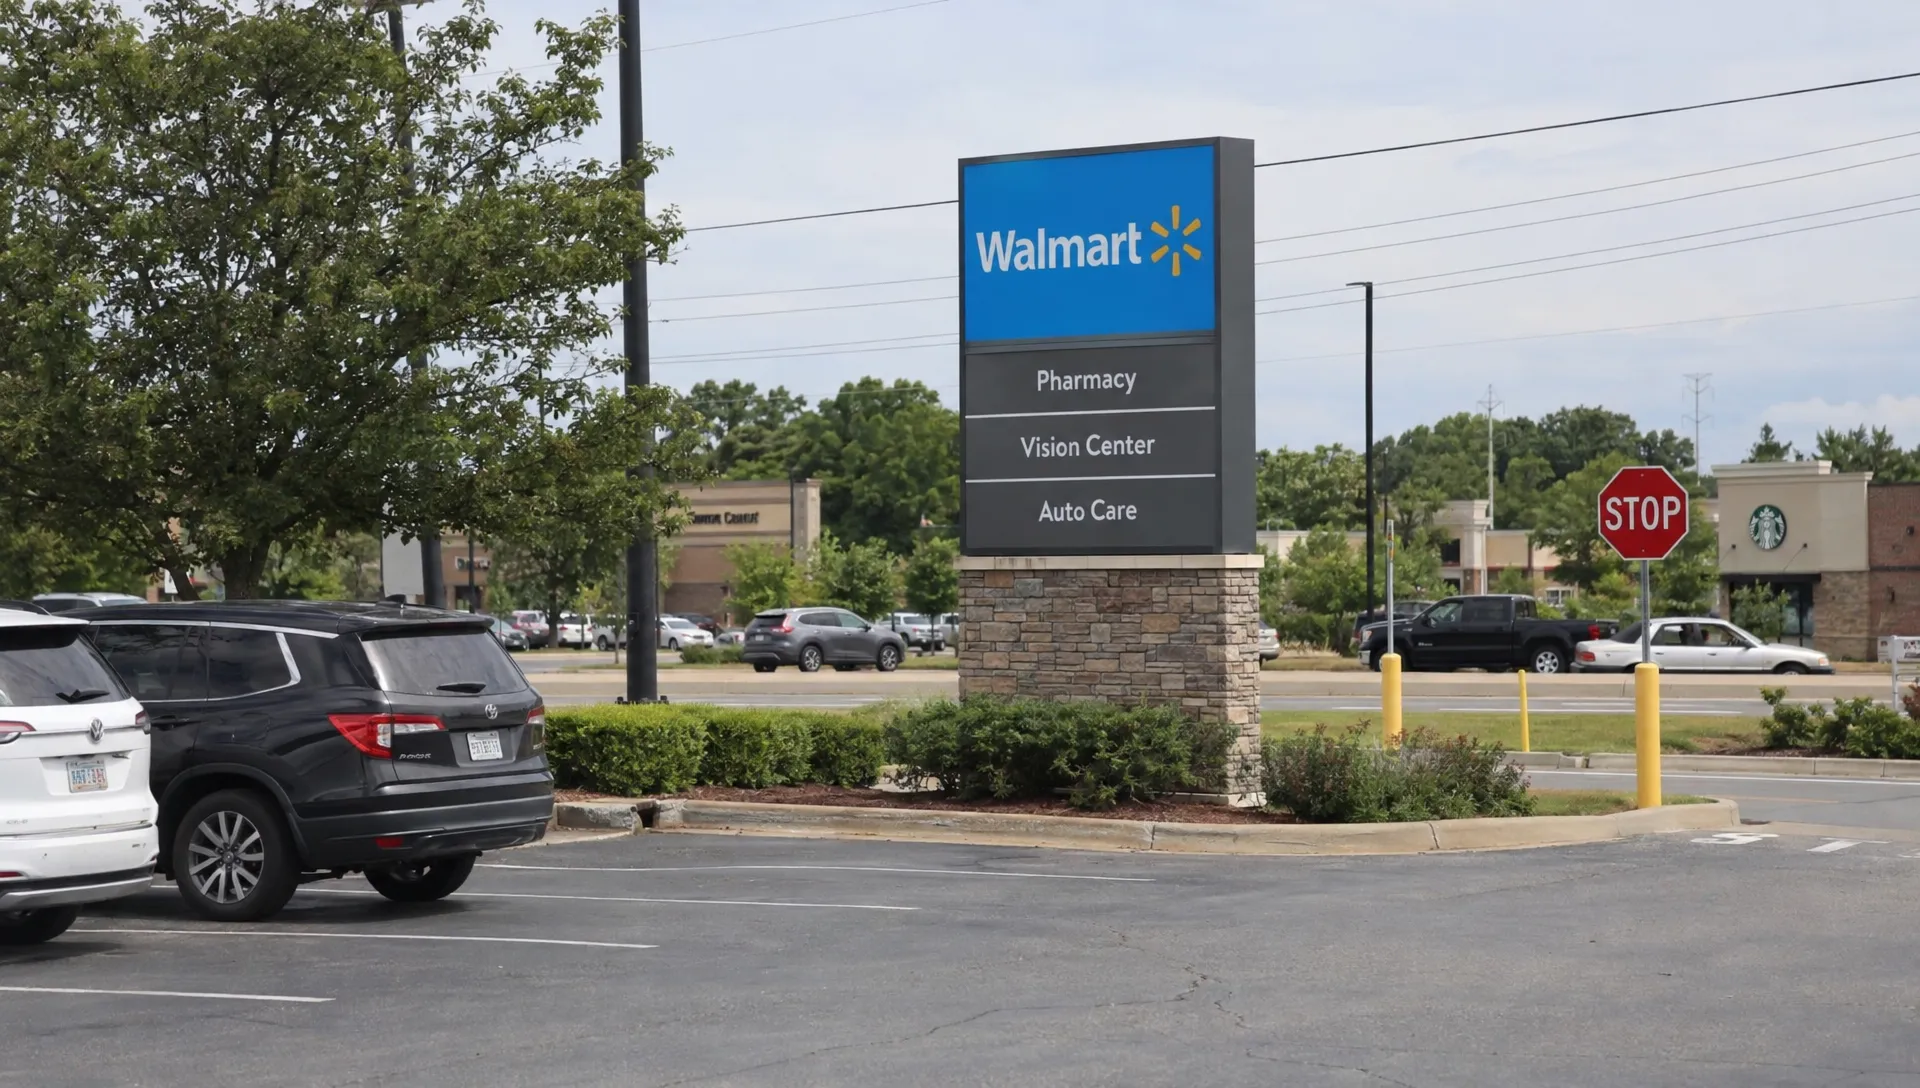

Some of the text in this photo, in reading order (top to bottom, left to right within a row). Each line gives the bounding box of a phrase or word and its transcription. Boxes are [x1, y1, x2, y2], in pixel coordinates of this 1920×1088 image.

[976, 222, 1142, 273] Walmart
[1036, 369, 1138, 396] Pharmacy
[1019, 433, 1156, 459] Vision Center
[1038, 498, 1138, 523] Auto Care
[1604, 495, 1681, 531] STOP
